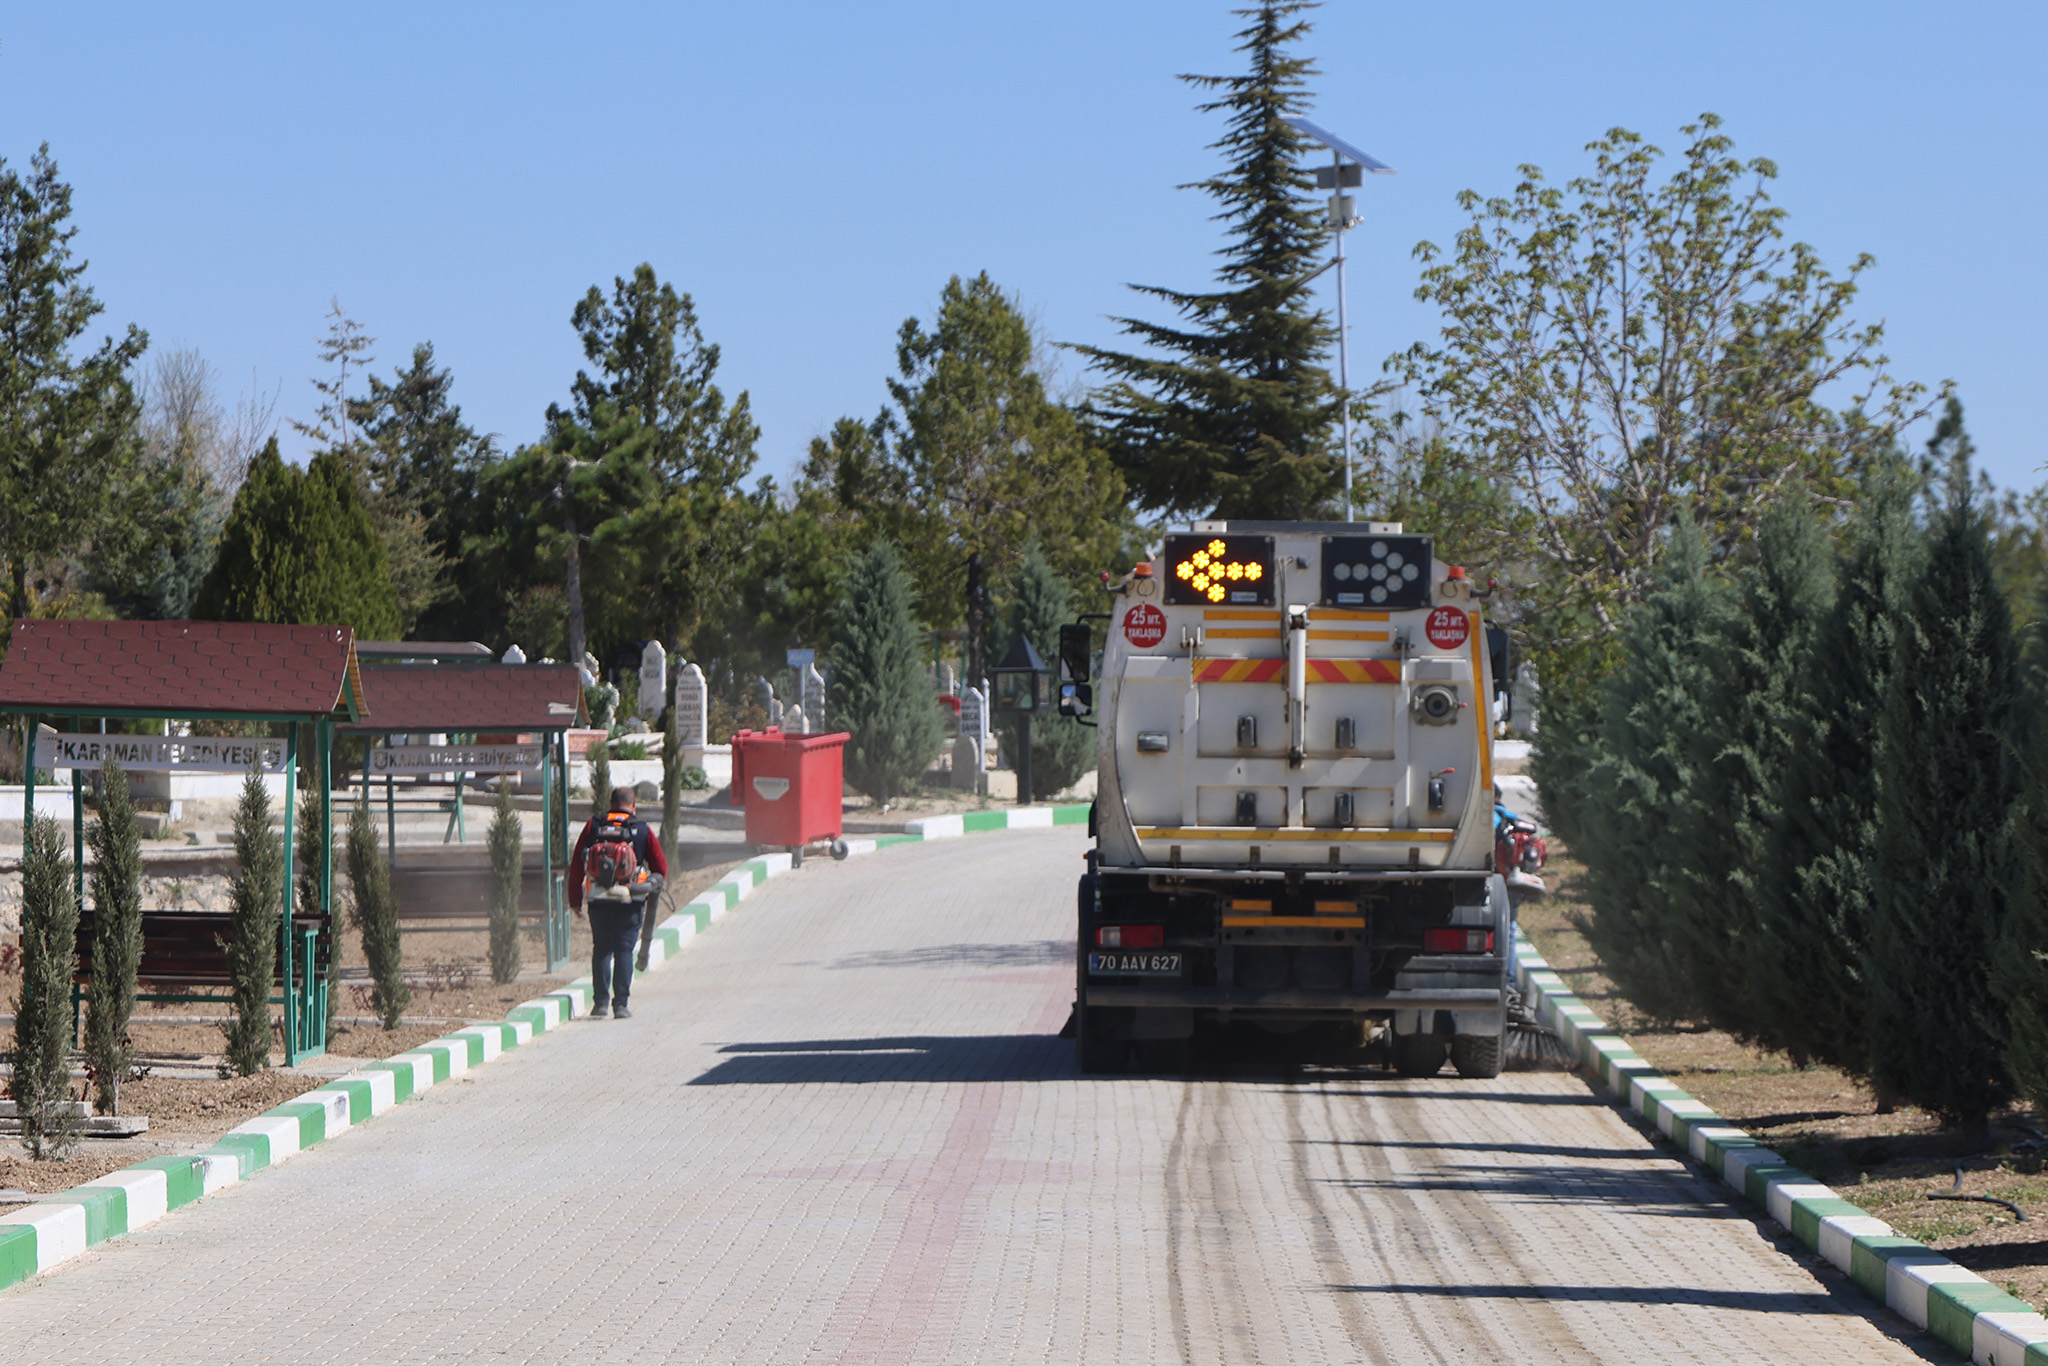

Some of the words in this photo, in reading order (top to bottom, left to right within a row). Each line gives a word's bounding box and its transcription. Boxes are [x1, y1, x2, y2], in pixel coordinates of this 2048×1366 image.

[1131, 610, 1146, 625] 25
[1434, 611, 1449, 626] 25
[1128, 627, 1162, 640] YAKLAŞMA
[1431, 629, 1466, 642] YAKLAŞMA
[64, 742, 153, 762] KARAMAN
[157, 742, 259, 764] BELEDİYESİ
[1099, 955, 1117, 970] 70
[1121, 955, 1148, 970] AAV
[1152, 955, 1179, 971] 627
